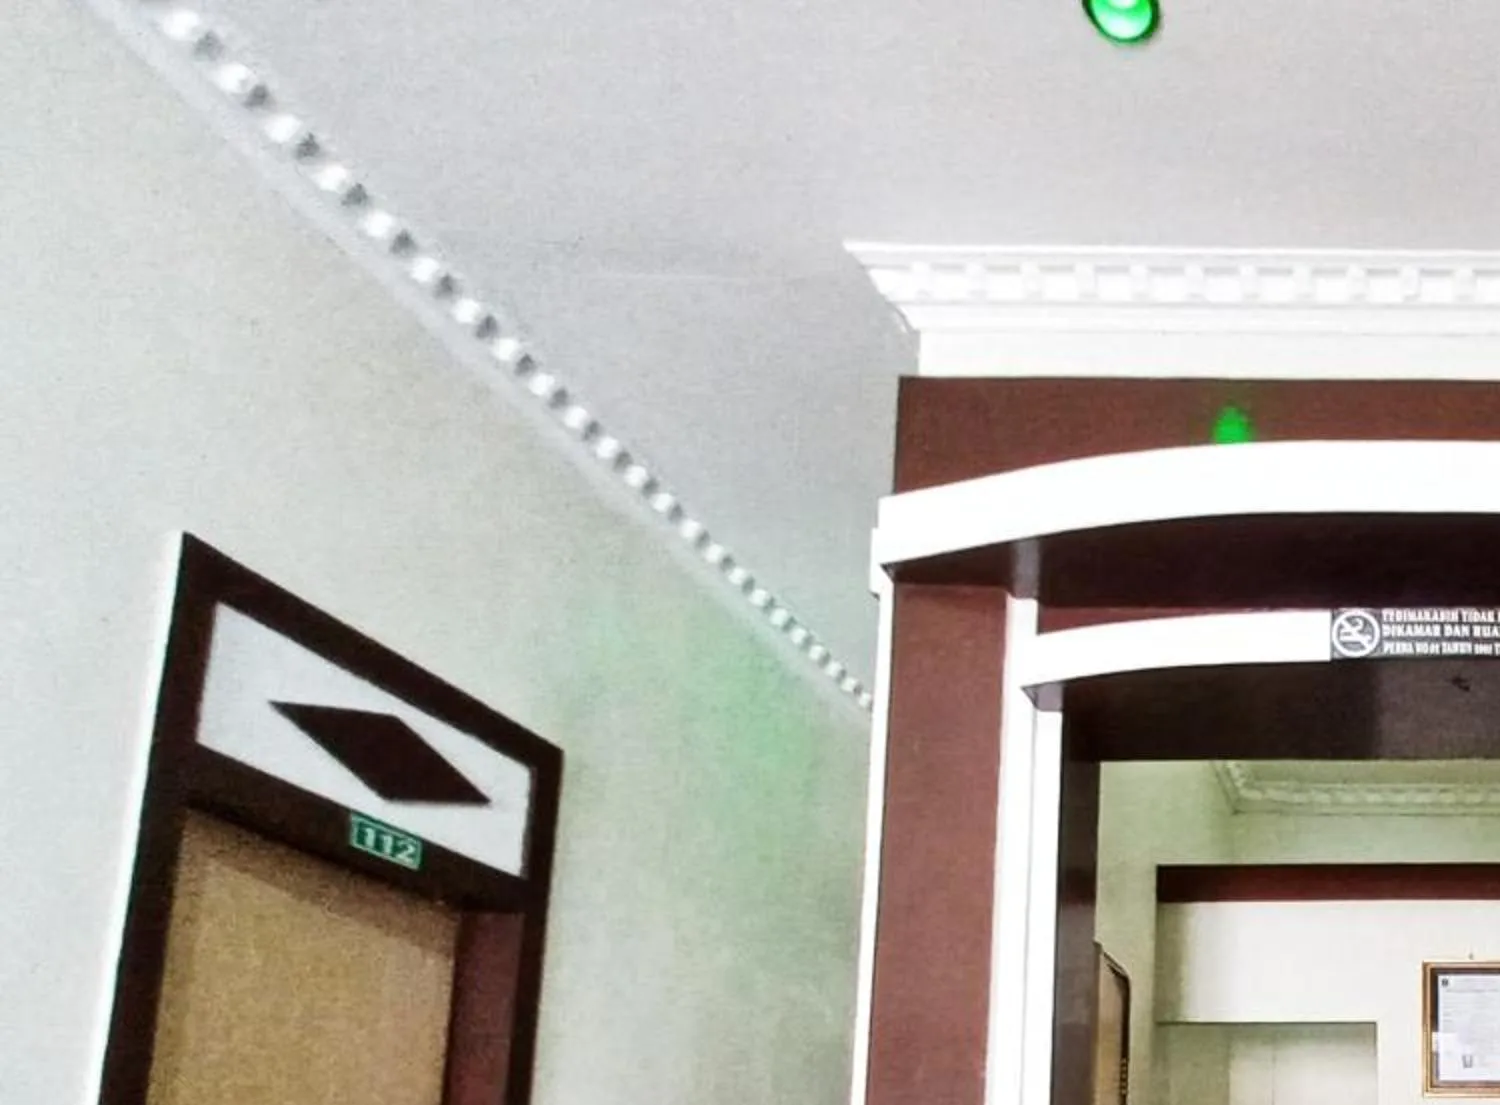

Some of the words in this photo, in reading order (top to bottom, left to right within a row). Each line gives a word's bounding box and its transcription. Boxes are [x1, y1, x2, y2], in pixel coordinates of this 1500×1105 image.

[1461, 609, 1495, 624] TIDAK
[1382, 624, 1441, 637] DIKAMAR
[1443, 625, 1470, 637] DAN
[364, 827, 417, 865] 112
